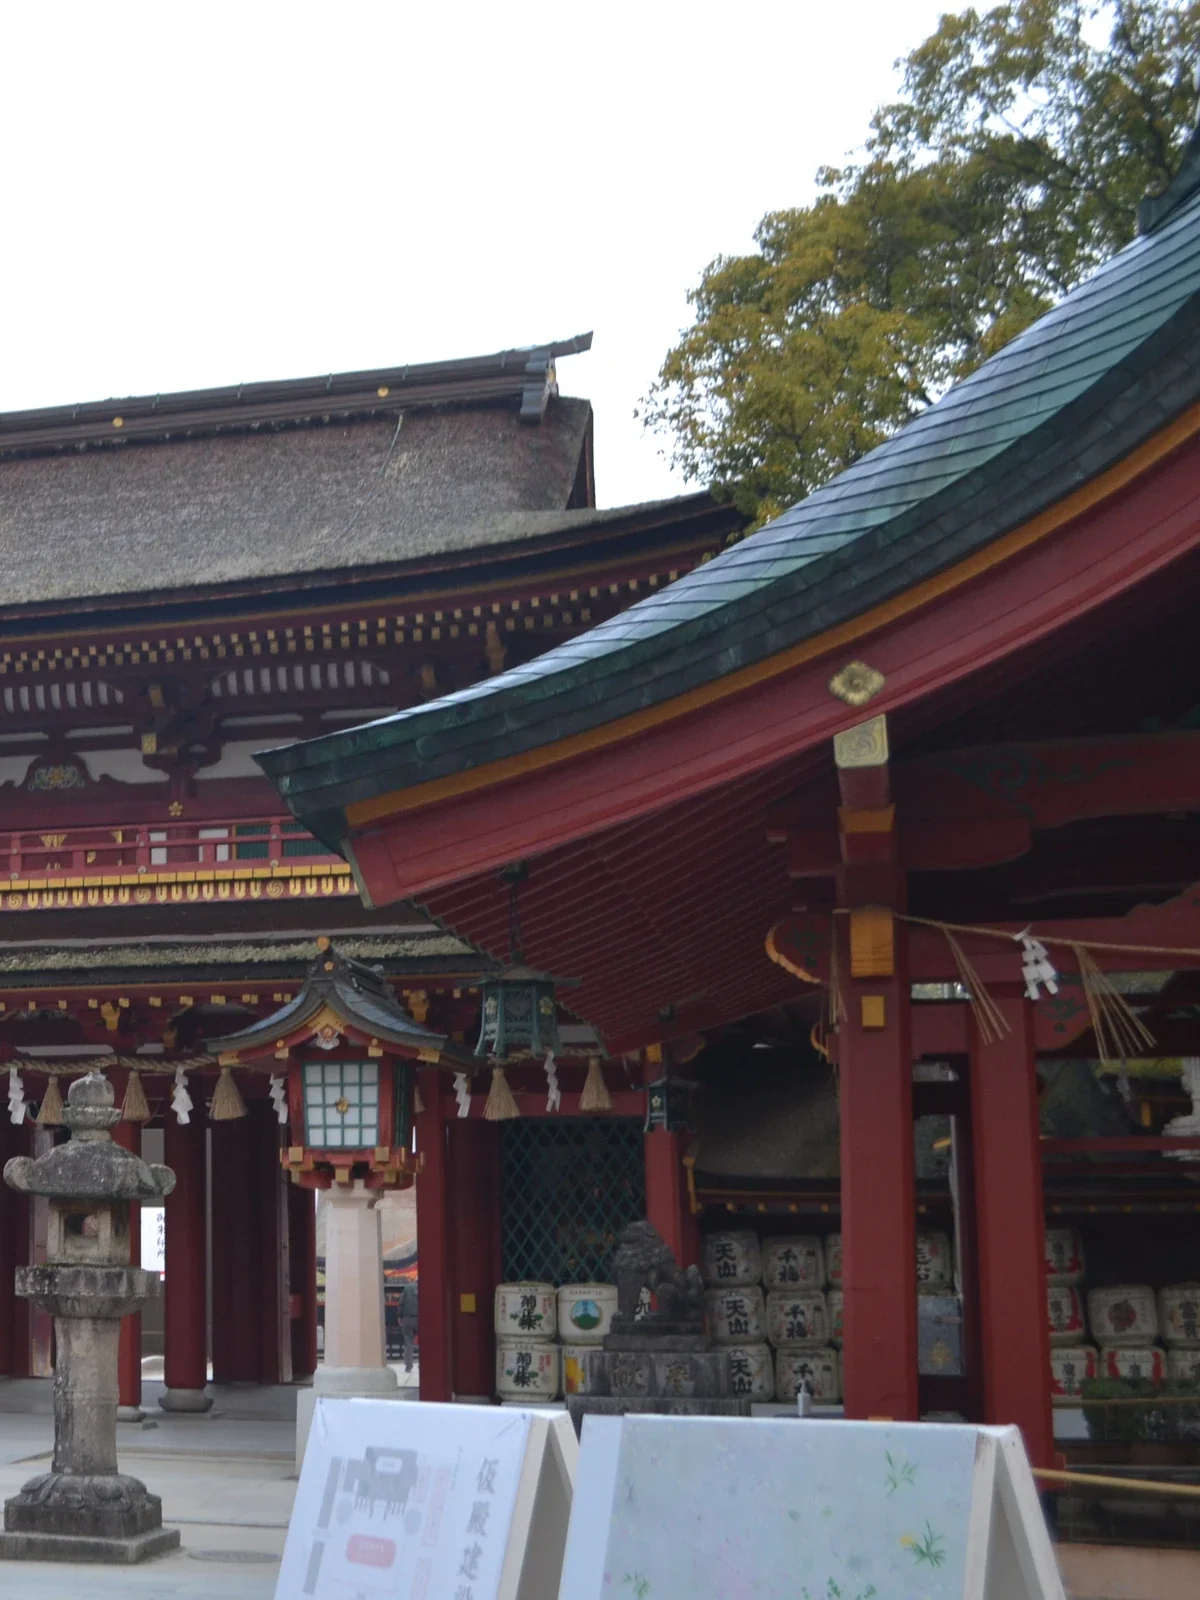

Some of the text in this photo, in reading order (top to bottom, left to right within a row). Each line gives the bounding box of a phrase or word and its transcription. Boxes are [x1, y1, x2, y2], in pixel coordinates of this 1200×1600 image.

[712, 1242, 736, 1278] 天山
[726, 1299, 748, 1335] 天山
[730, 1357, 753, 1395] 天山
